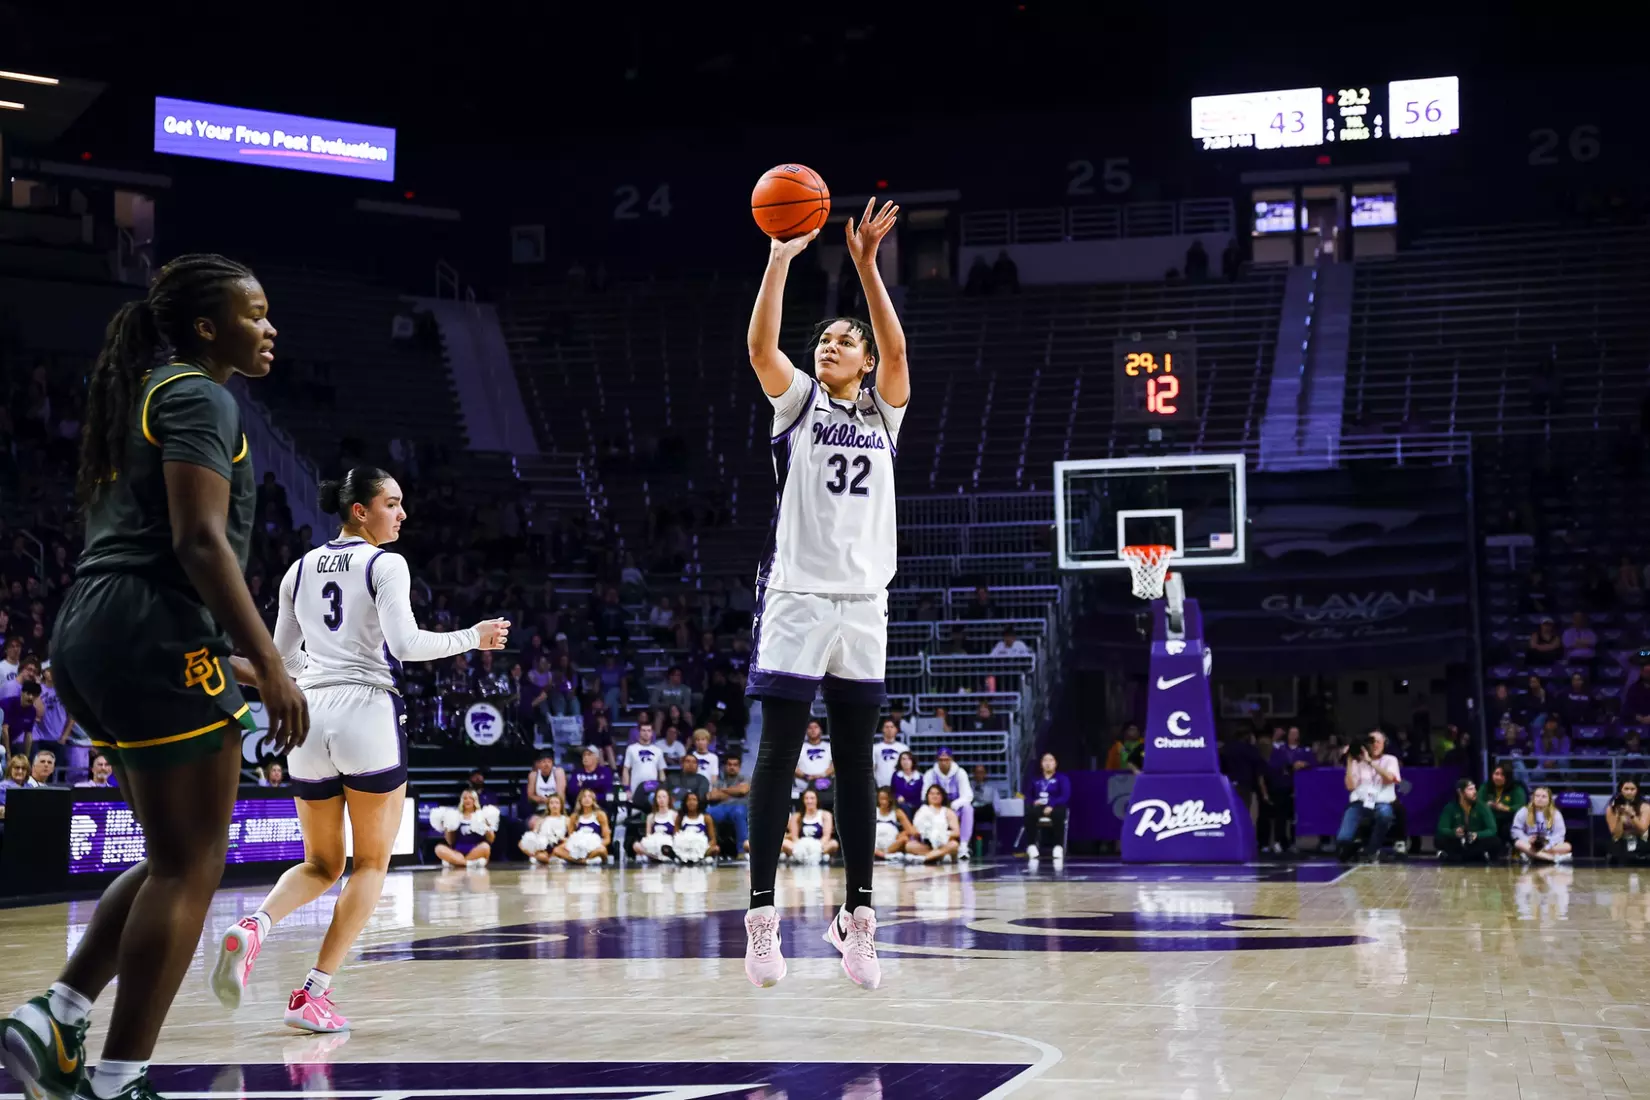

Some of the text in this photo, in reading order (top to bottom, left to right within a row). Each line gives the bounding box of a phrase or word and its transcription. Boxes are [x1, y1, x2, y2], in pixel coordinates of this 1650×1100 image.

[1337, 87, 1370, 106] 29.2
[1405, 99, 1442, 124] 56
[163, 116, 193, 136] Get
[195, 120, 233, 141] Your
[235, 125, 271, 146] Free
[310, 136, 388, 161] Evaluation
[1269, 110, 1305, 133] 43
[1528, 124, 1601, 165] 26
[1066, 157, 1132, 195] 25
[614, 183, 673, 219] 24
[1125, 352, 1172, 376] 29.1
[1147, 375, 1179, 414] 12
[812, 421, 886, 449] Wildcats
[826, 453, 871, 497] 32
[316, 552, 354, 573] GLENN
[321, 581, 343, 631] 3
[1261, 588, 1435, 611] GLAVAN
[184, 647, 226, 696] BU
[1154, 736, 1206, 749] Channel
[1129, 799, 1232, 838] Dillons
